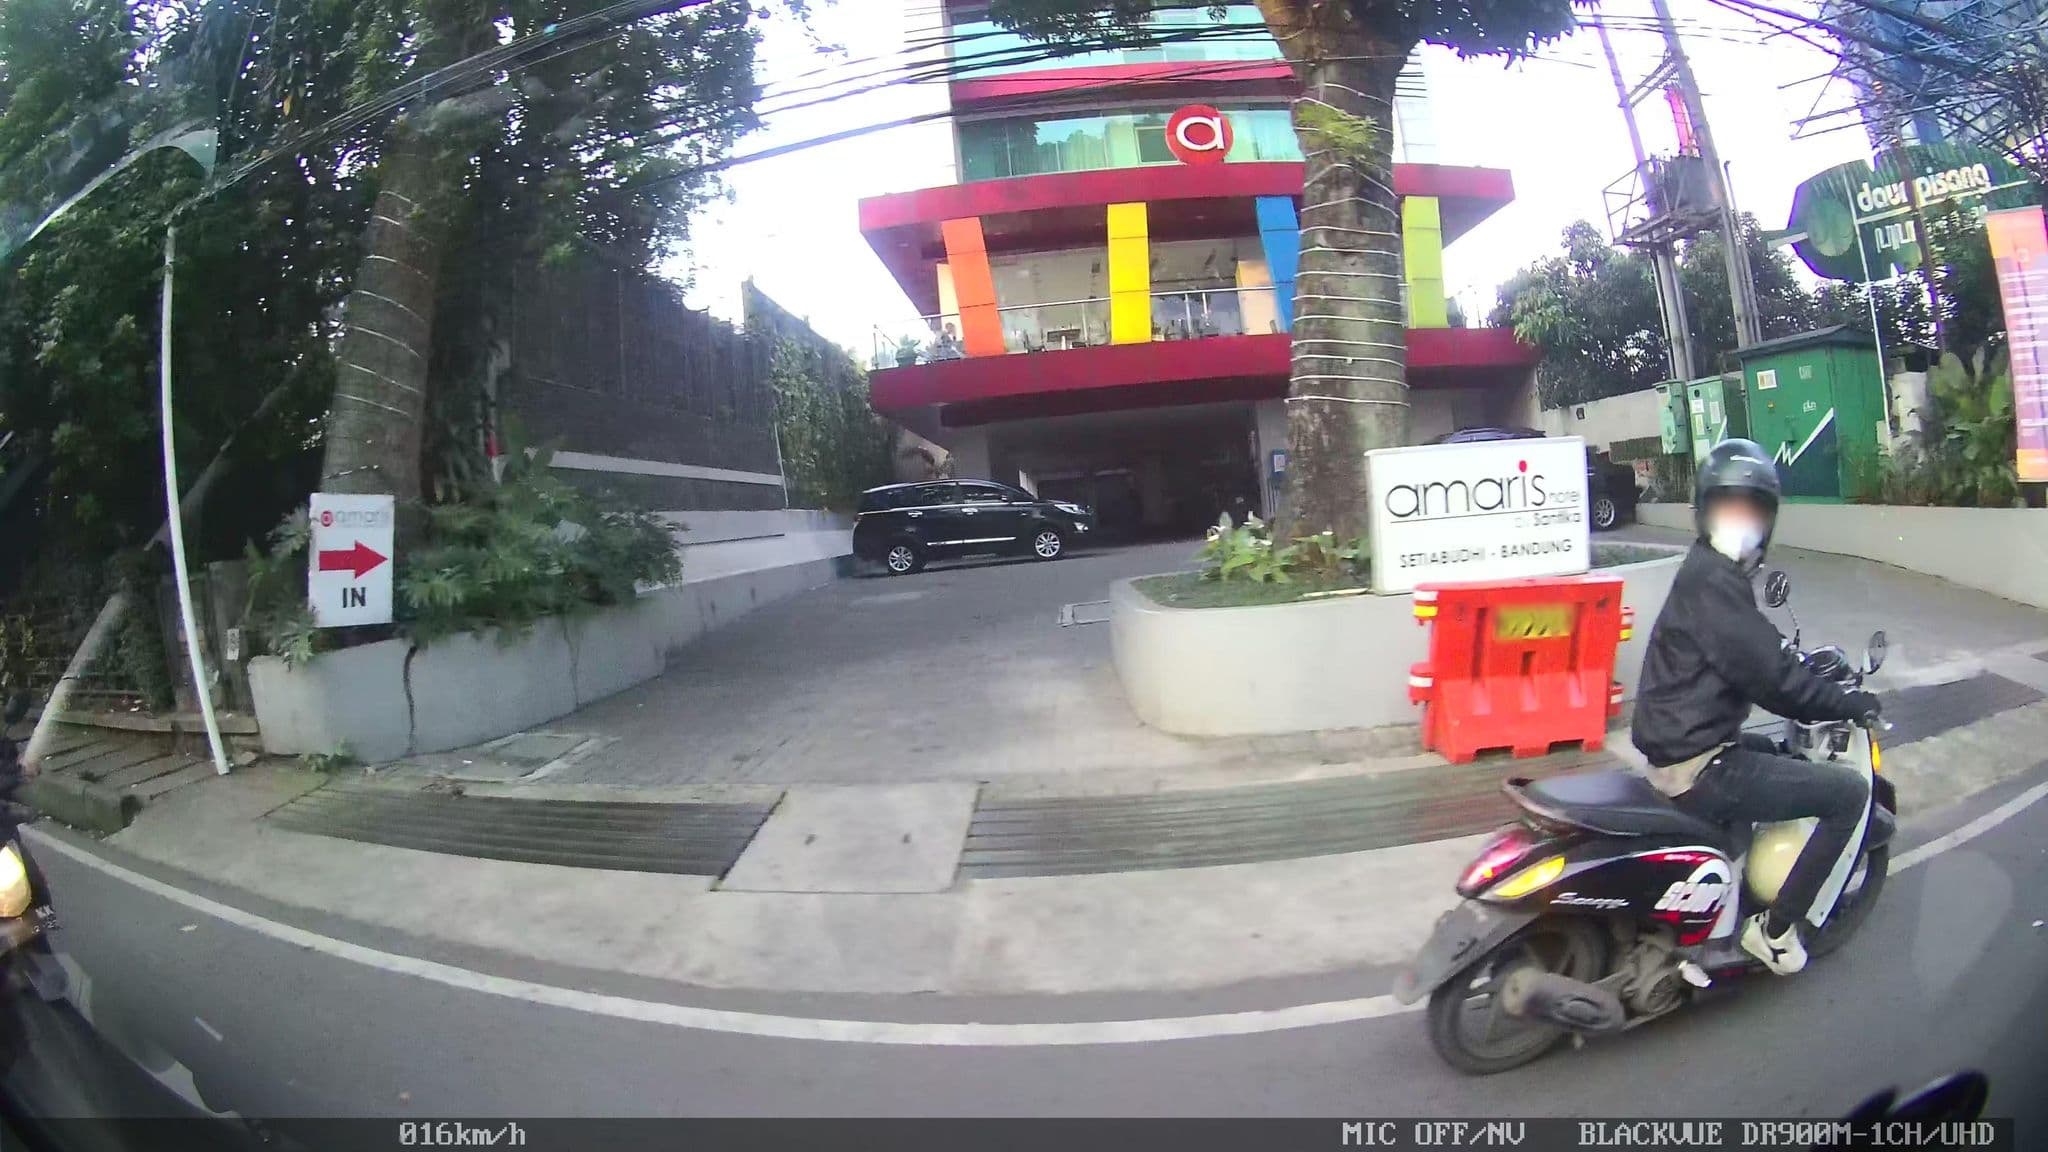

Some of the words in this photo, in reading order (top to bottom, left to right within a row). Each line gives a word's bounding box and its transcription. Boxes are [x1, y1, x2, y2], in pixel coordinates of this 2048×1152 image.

[1176, 116, 1224, 151] a
[1912, 163, 1991, 207] pisang
[1385, 460, 1546, 518] amaris
[1400, 547, 1486, 569] SETIABUDHI
[1501, 538, 1573, 560] BANDUNG
[342, 587, 367, 608] IN
